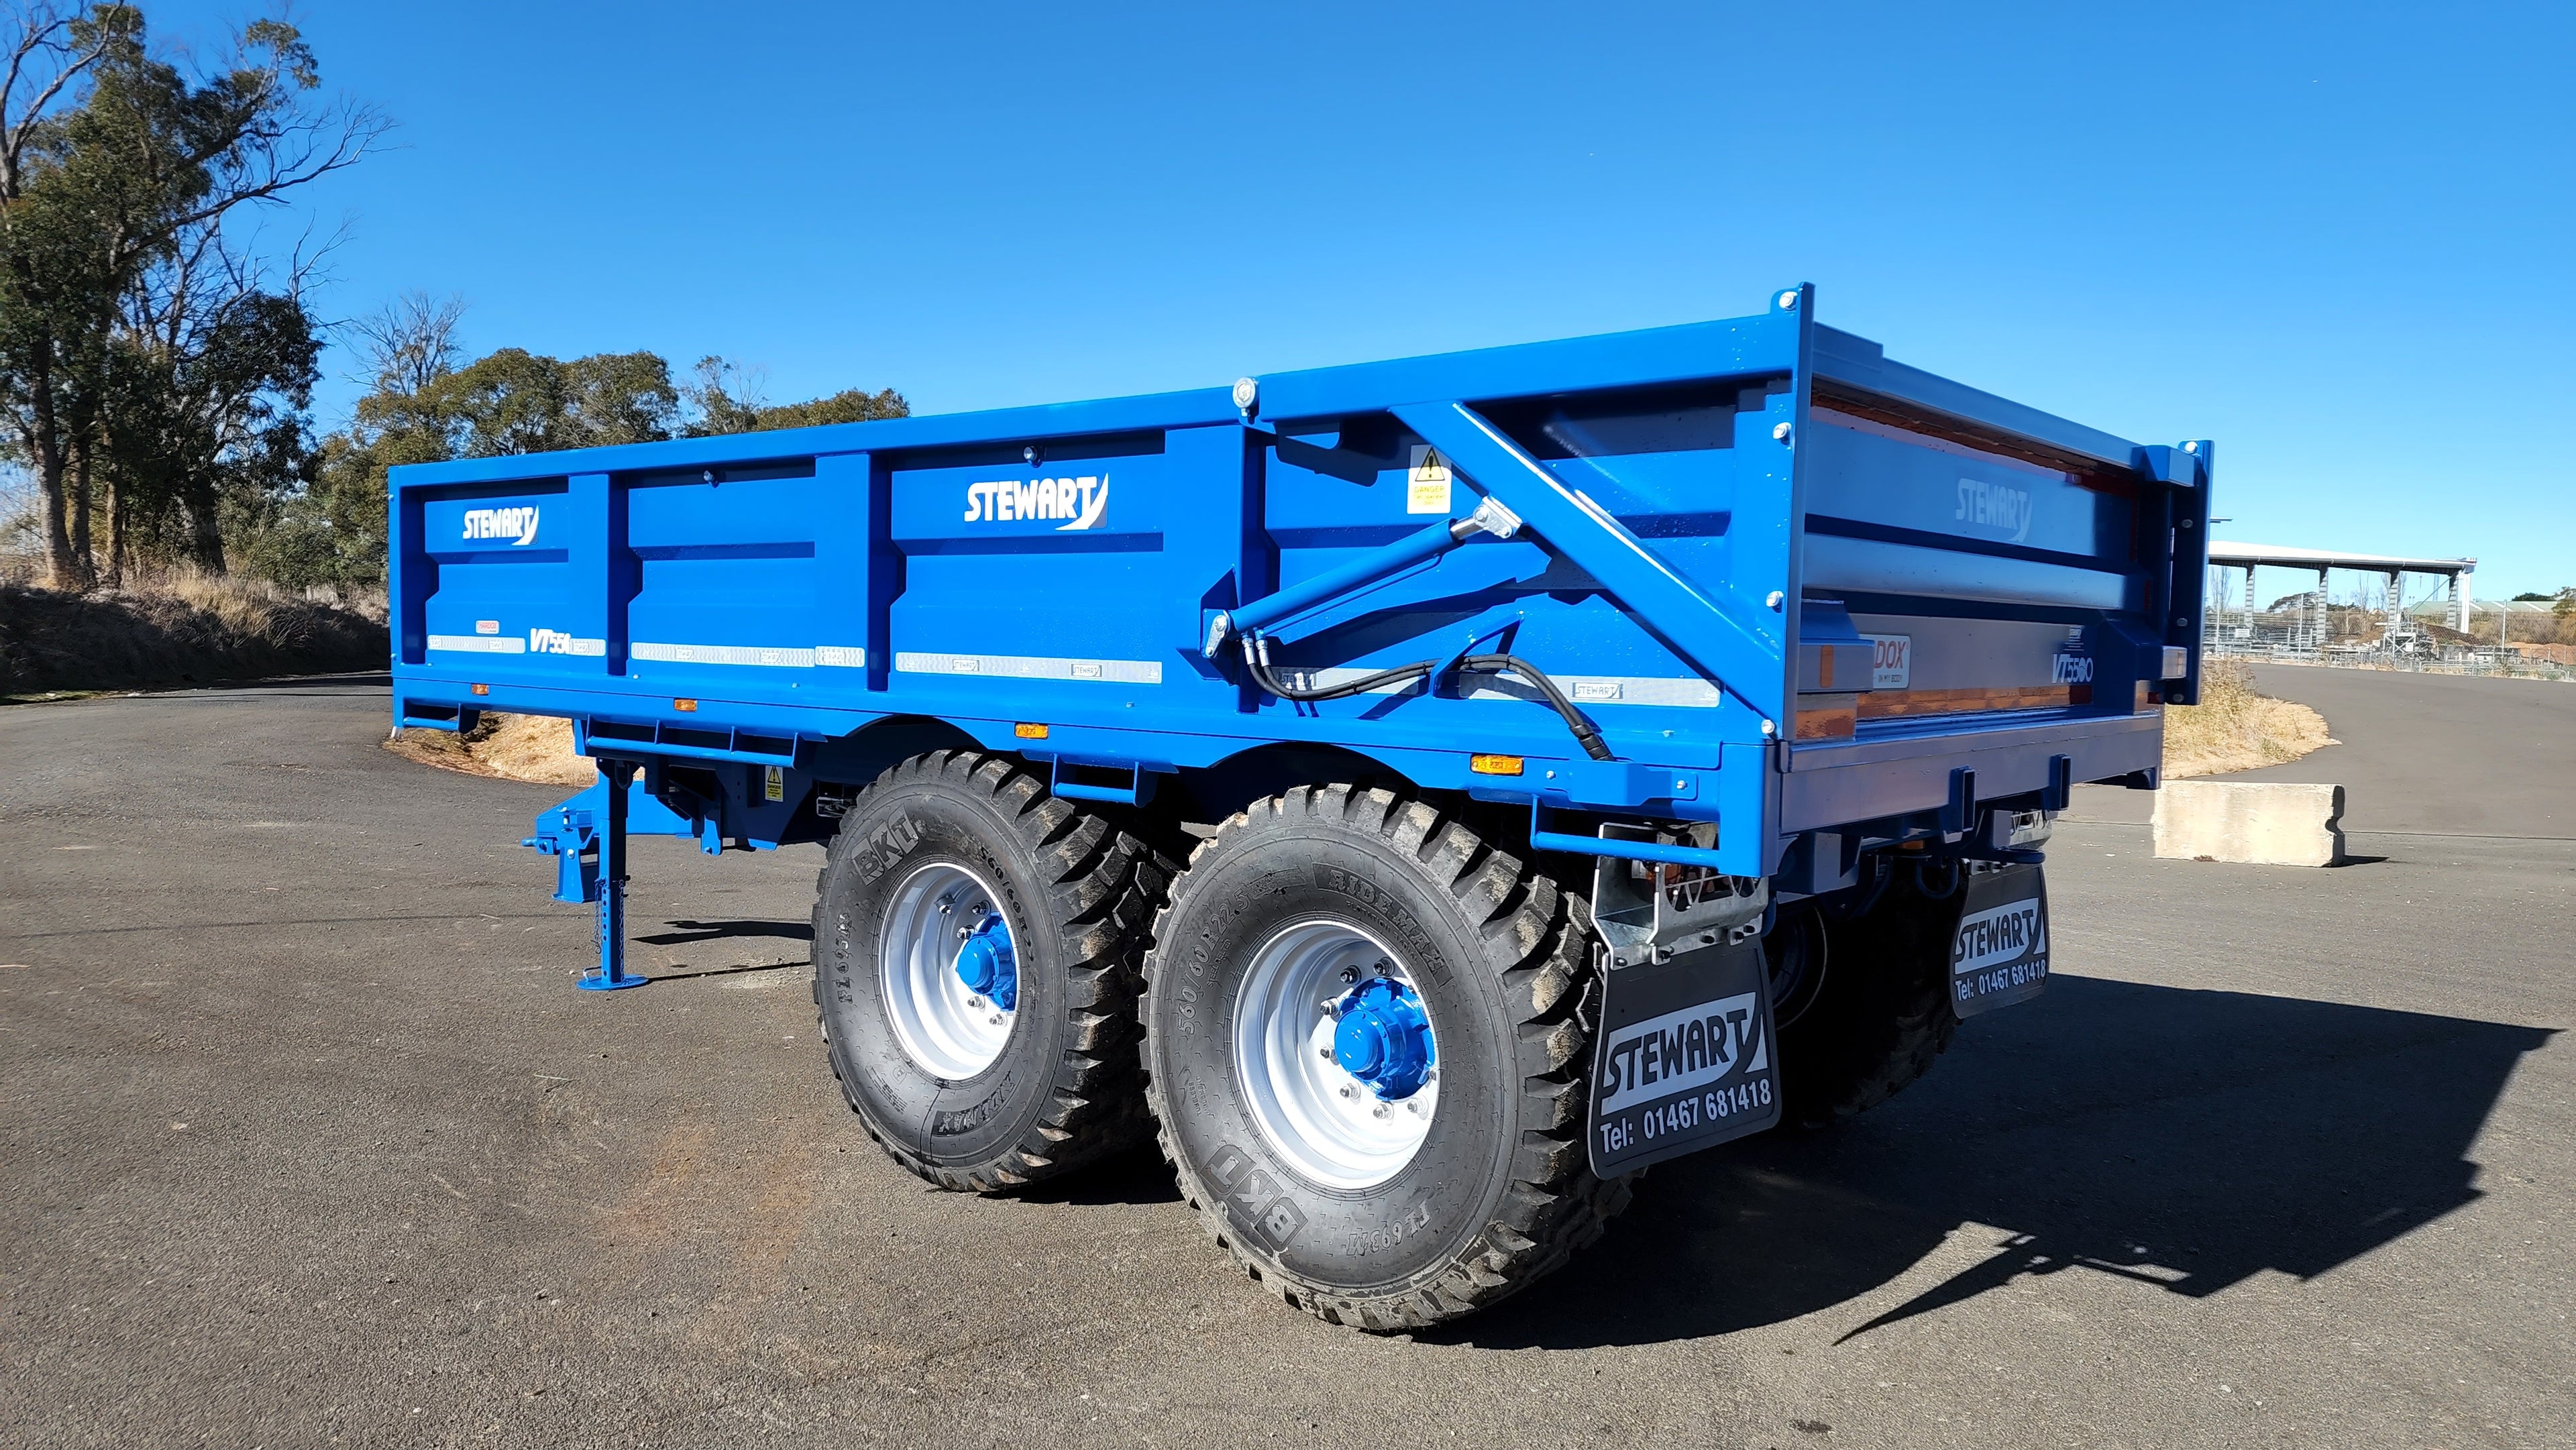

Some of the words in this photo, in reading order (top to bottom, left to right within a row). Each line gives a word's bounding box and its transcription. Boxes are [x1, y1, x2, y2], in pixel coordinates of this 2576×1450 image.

[462, 504, 539, 545] STEWART
[964, 473, 1108, 530] STEWART
[1955, 478, 2033, 542] STEWART
[1073, 666, 1099, 676] STEWART
[1874, 640, 1906, 669] DOX
[1575, 684, 1621, 698] STEWART
[852, 809, 915, 880] BKT
[1954, 908, 2037, 964] STEWART
[1955, 978, 1974, 1001] Tel:
[1979, 968, 2009, 996] 01467
[2012, 959, 2046, 987] 681418
[1601, 1007, 1759, 1101] STEWART
[1601, 1117, 1634, 1154] Tel:
[1644, 1097, 1699, 1140] 01467
[1705, 1078, 1772, 1121] 681418
[1206, 1152, 1301, 1245] BKT
